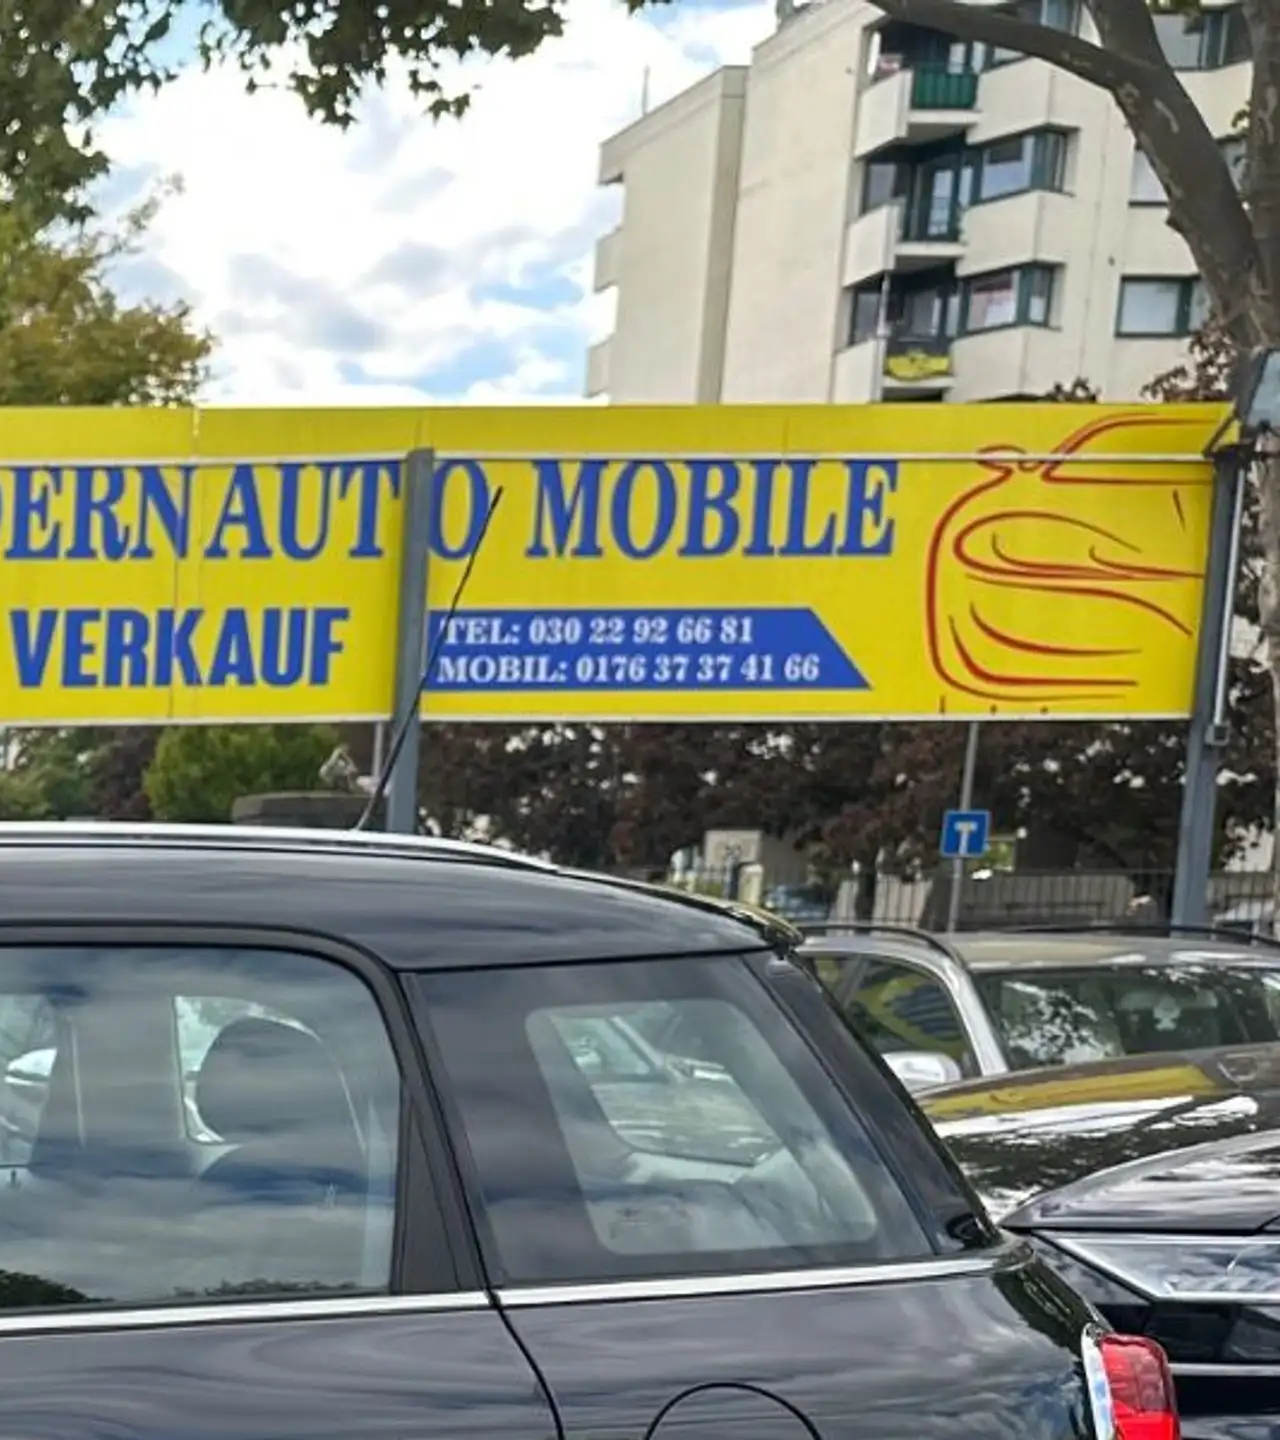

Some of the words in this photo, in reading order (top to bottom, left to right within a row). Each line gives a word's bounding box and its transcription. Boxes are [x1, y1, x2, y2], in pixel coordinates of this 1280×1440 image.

[525, 460, 899, 558] MOBILE
[9, 607, 350, 689] VERKAUF
[442, 616, 520, 645] TEL:
[528, 616, 582, 645] 030
[589, 616, 626, 645] 22
[632, 616, 669, 645] 92
[676, 616, 713, 645] 66
[719, 615, 754, 645] 81
[436, 654, 567, 684] MOBIL:
[575, 654, 646, 683] 0176
[653, 654, 689, 682] 37
[697, 654, 733, 682] 37
[740, 653, 773, 682] 41
[783, 653, 820, 682] 66
